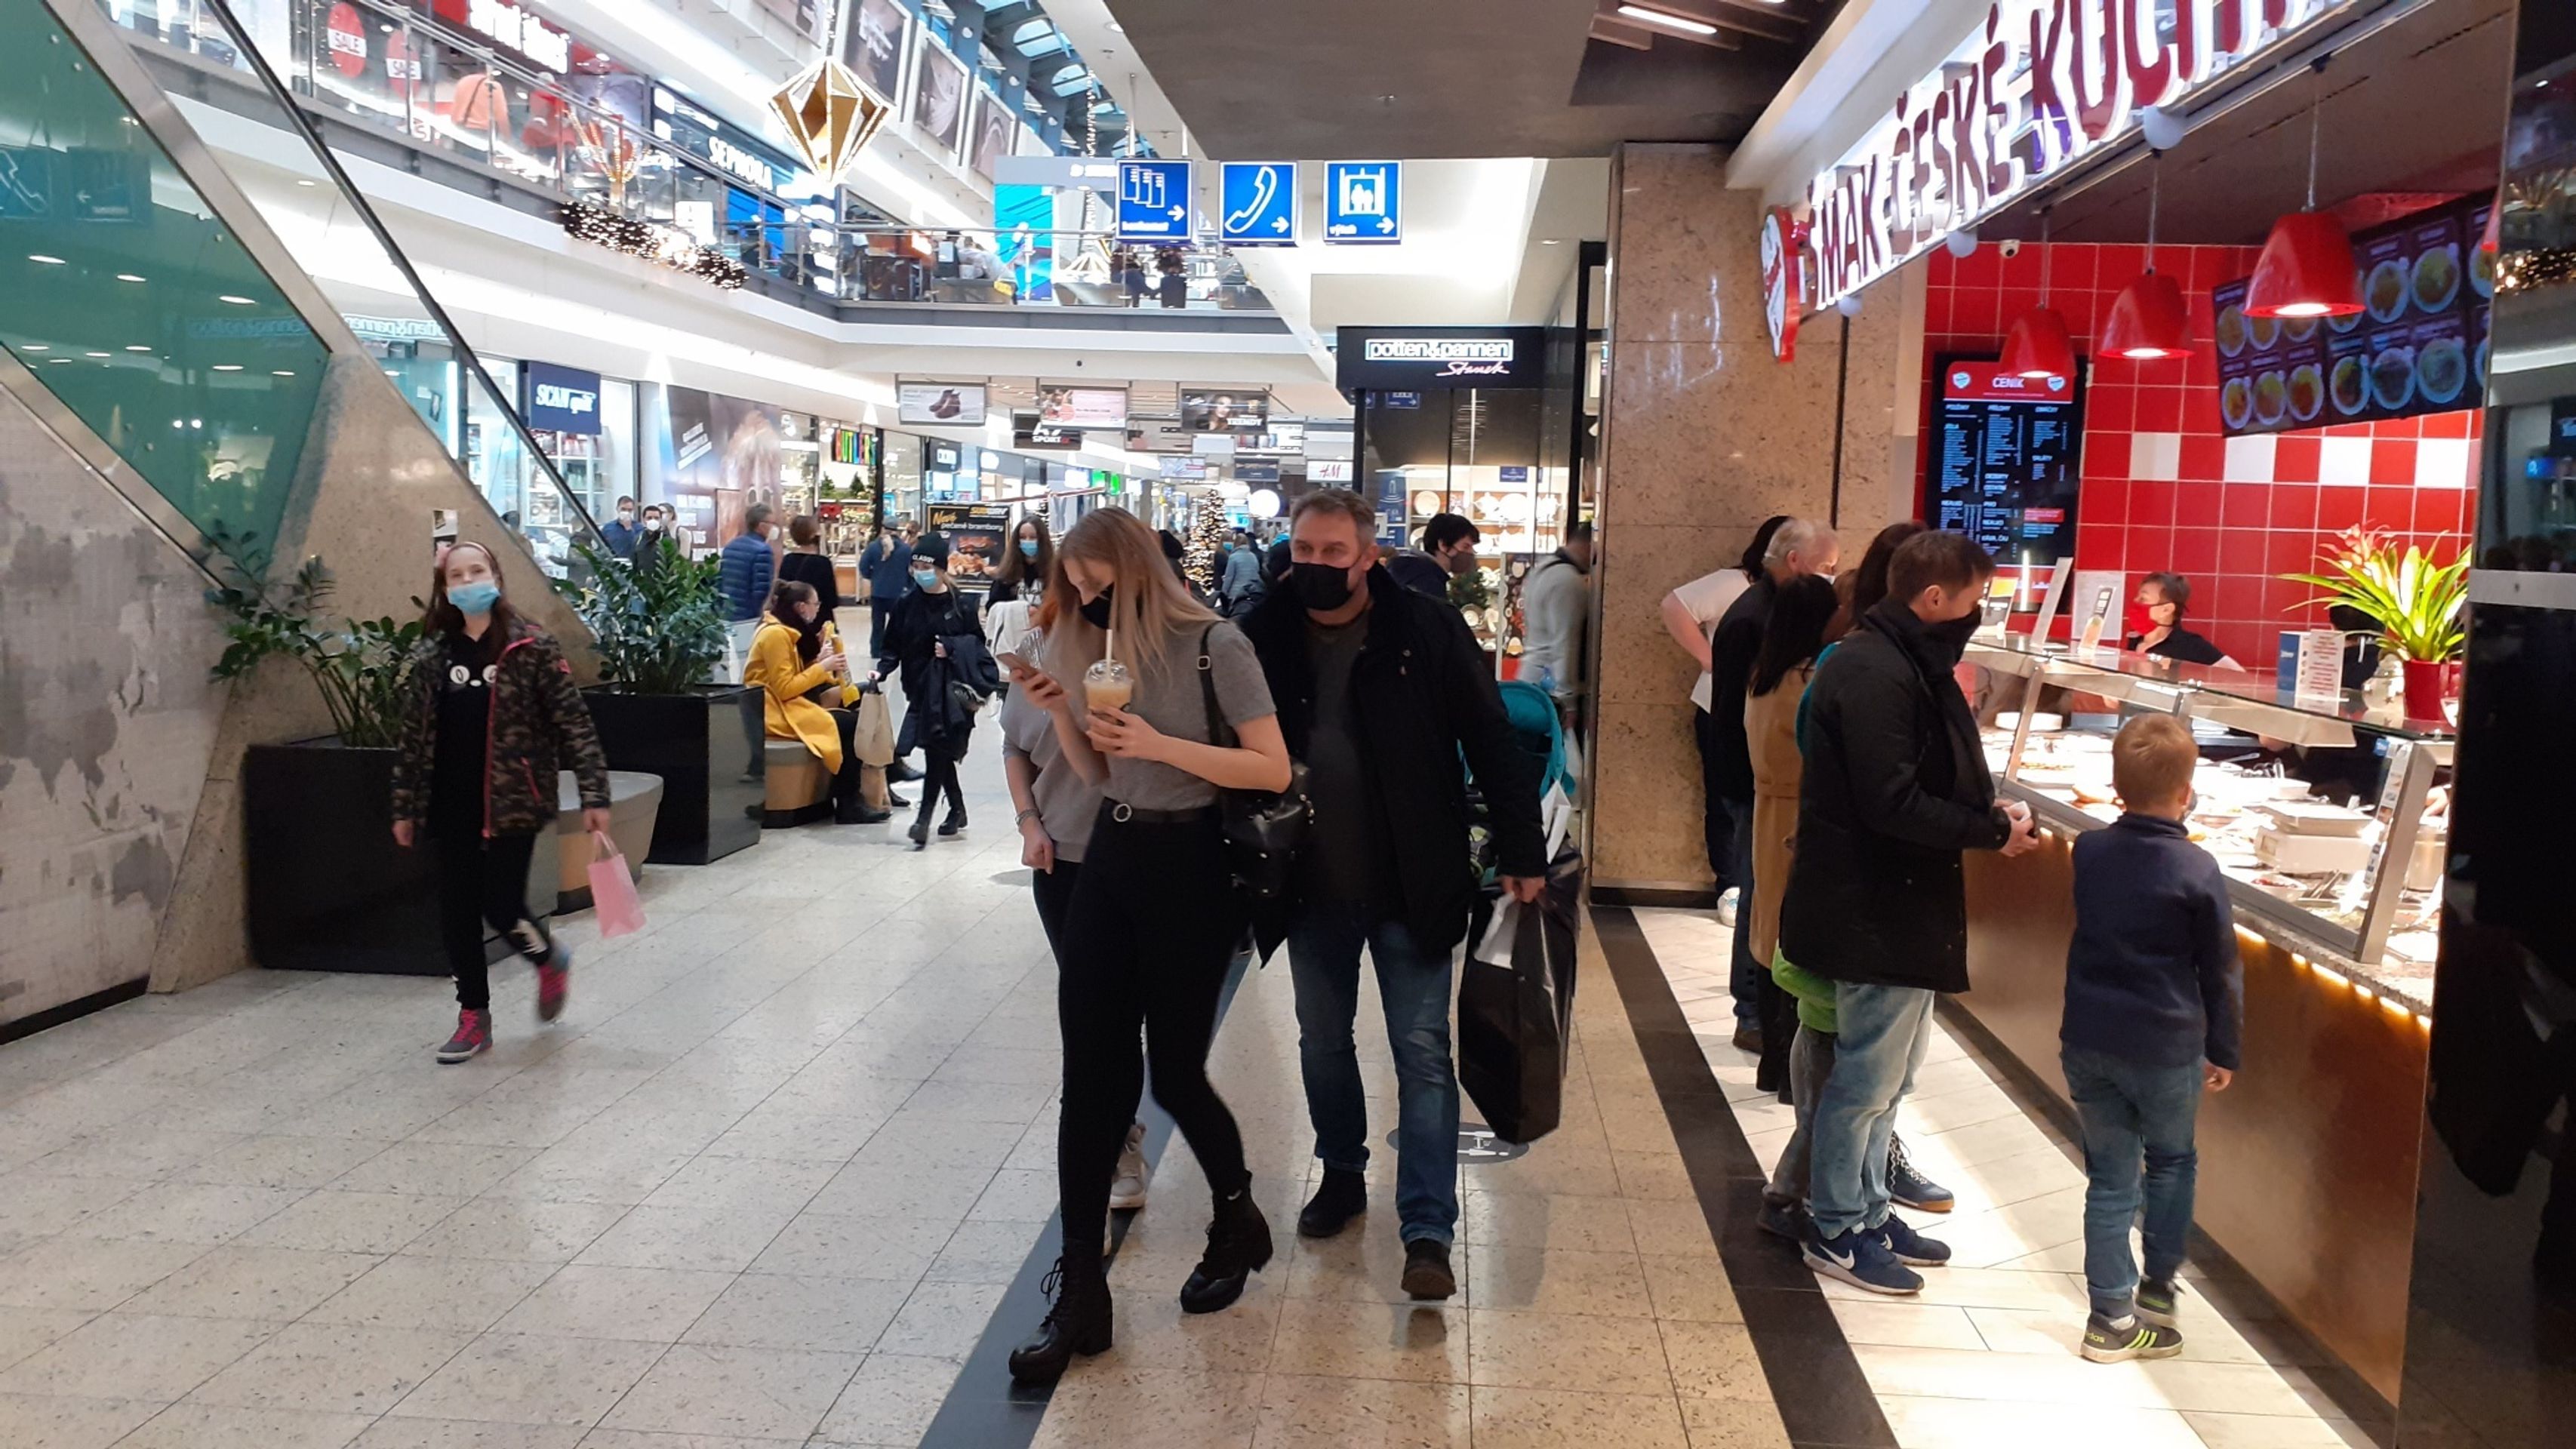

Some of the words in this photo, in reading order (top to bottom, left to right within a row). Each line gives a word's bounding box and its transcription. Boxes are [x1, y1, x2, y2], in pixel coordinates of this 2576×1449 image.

[334, 31, 362, 54] SALE
[392, 60, 417, 77] SAE
[1368, 340, 1510, 358] potten&pannen
[536, 383, 569, 408] SCAN
[912, 554, 935, 564] CLASSY
